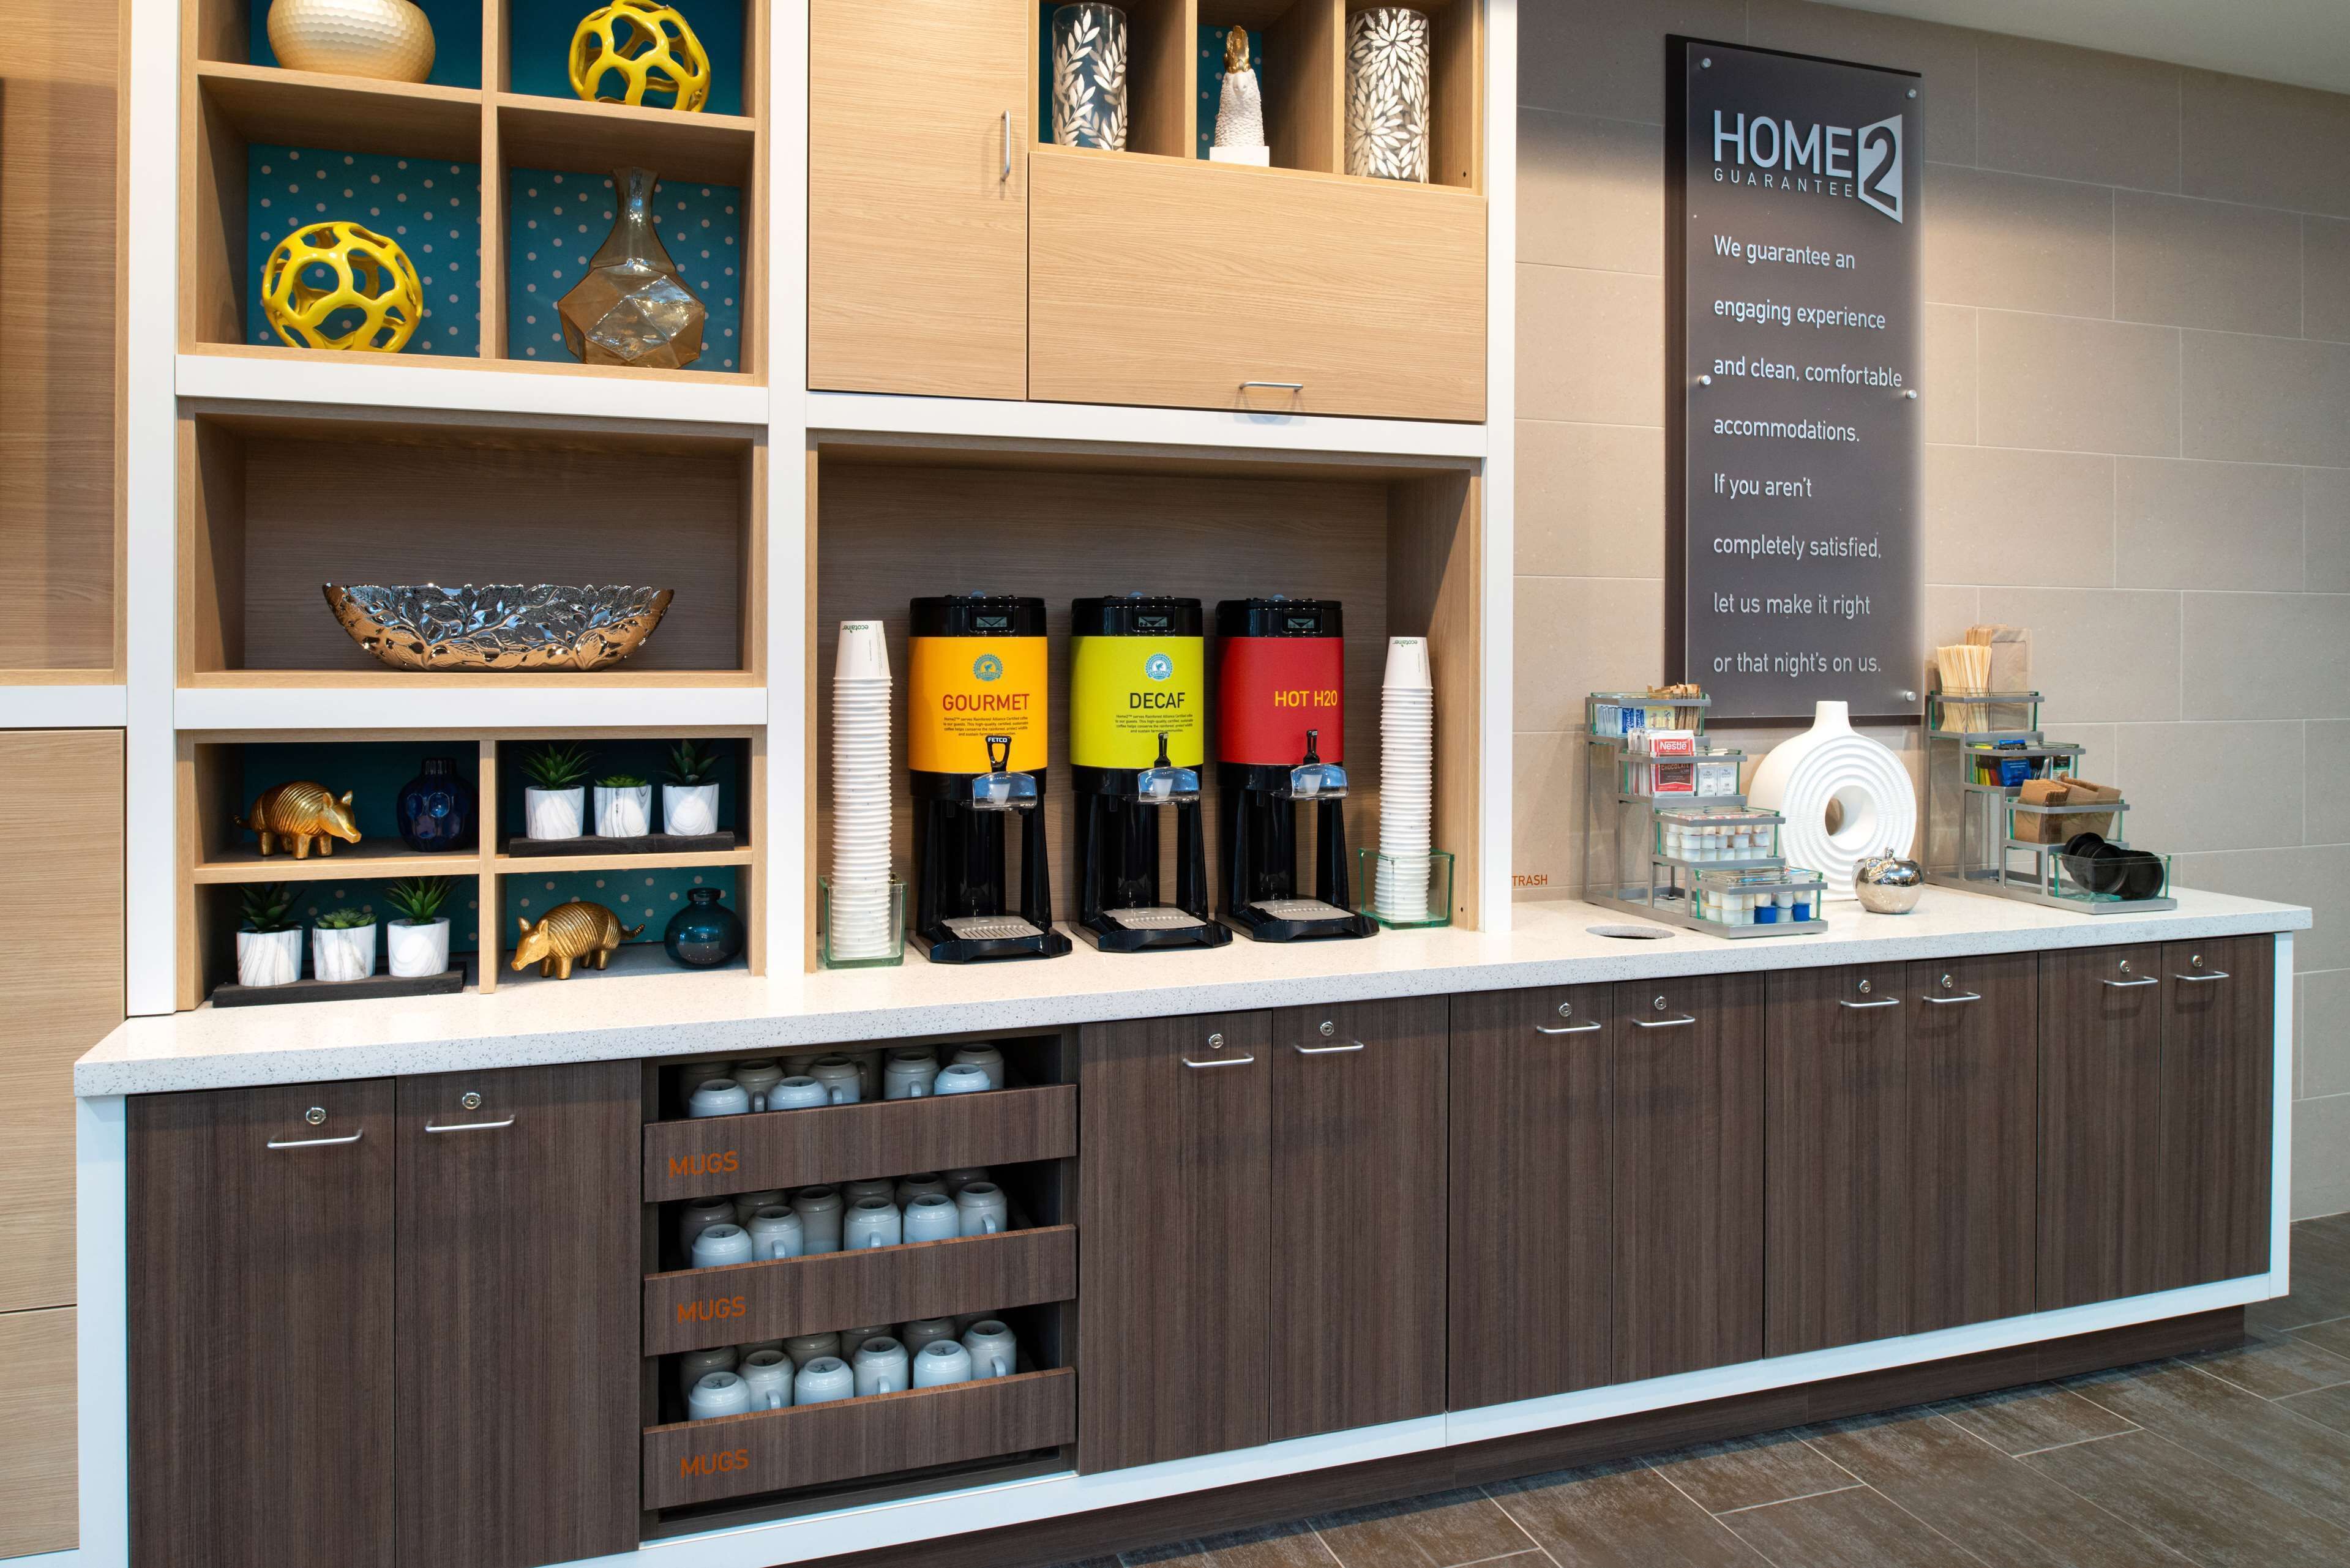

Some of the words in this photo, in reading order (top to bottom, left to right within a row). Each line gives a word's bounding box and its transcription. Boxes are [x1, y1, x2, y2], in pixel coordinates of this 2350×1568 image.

[1714, 168, 1852, 197] GUARANTEE
[1714, 235, 1740, 257] We
[1747, 244, 1830, 266] guarantee
[1836, 253, 1855, 269] an
[1715, 299, 1791, 326] engaging
[1797, 306, 1885, 329] experience
[1714, 356, 1745, 376] and
[1751, 357, 1800, 381] clean,
[1805, 364, 1902, 387] comfortable
[1714, 417, 1860, 442] accommodations.
[1715, 473, 1725, 494] If
[1729, 479, 1759, 499] you
[1765, 477, 1811, 497] aren't
[1714, 534, 1805, 560] completely
[1810, 537, 1881, 558] satisfied,
[1714, 592, 1734, 613] let
[1740, 598, 1760, 613] us
[1767, 593, 1812, 614] make
[1819, 594, 1827, 614] it
[1833, 594, 1870, 619] right
[1714, 657, 1732, 672] or
[1737, 652, 1768, 673] that
[1775, 652, 1827, 678] night's
[1833, 657, 1852, 672] on
[1858, 657, 1881, 672] us.
[943, 694, 1030, 711] GOURMET
[1130, 692, 1185, 709] DECAF
[1275, 690, 1309, 707] HOT
[1511, 874, 1547, 887] TRASH
[669, 1151, 739, 1178] MUGS
[677, 1296, 746, 1324] MUGS
[681, 1449, 749, 1479] MUGS
